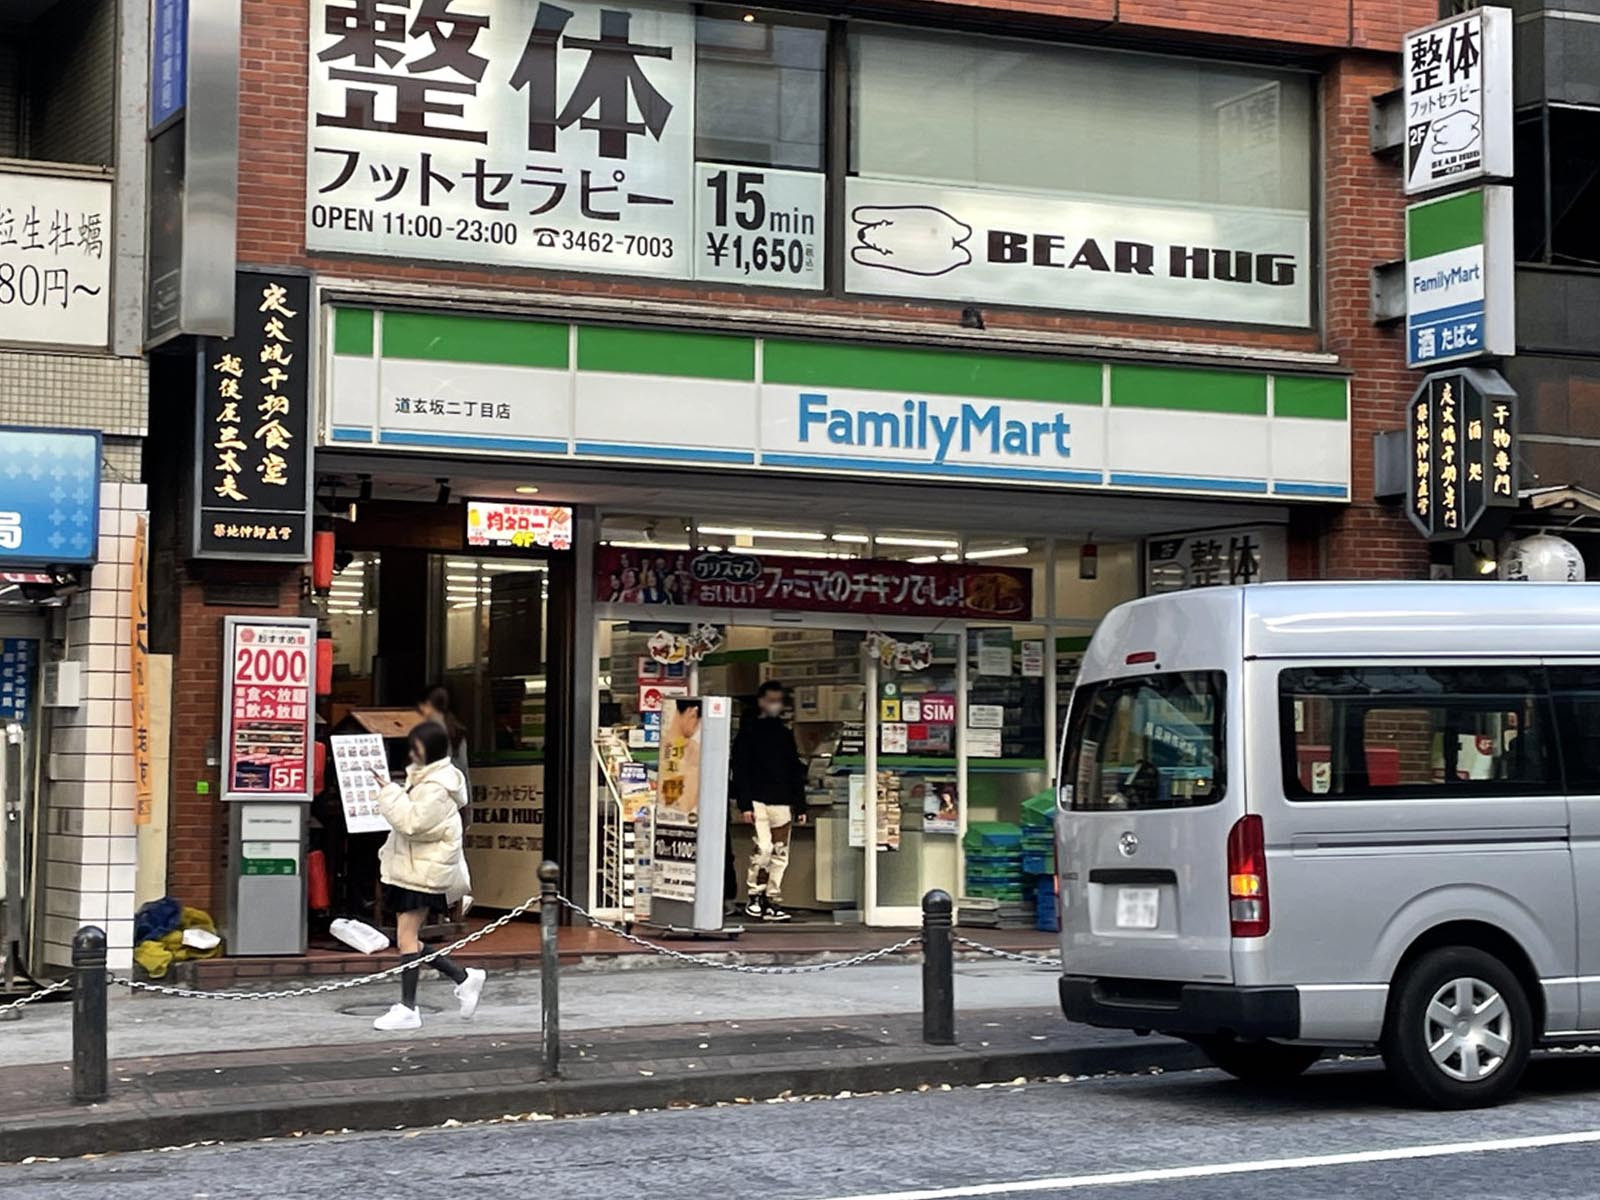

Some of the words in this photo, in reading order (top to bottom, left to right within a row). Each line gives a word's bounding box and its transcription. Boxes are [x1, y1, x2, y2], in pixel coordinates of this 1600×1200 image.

[1410, 21, 1480, 96] 整体
[316, 0, 673, 160] 整体
[1410, 87, 1480, 118] フットセラピー
[1410, 126, 1426, 147] 2F
[314, 147, 674, 221] フットセラピー
[311, 204, 374, 232] OPEN
[707, 232, 804, 275] ¥1,650
[987, 230, 1154, 276] BEAR
[1169, 245, 1297, 287] HUG
[1413, 264, 1481, 294] FamilyMart
[1418, 327, 1436, 359] 酒
[1442, 323, 1478, 351] たばこ
[395, 397, 511, 419] 道玄坂二丁目店
[798, 392, 1071, 464] FamilyMart
[1493, 405, 1510, 495] 干物専門
[696, 560, 756, 578] クリスマス
[1190, 535, 1259, 588] 整体
[247, 687, 307, 703] 食べ放題
[246, 704, 306, 720] 飲み放題
[923, 704, 954, 720] SIM
[274, 768, 303, 788] 5F
